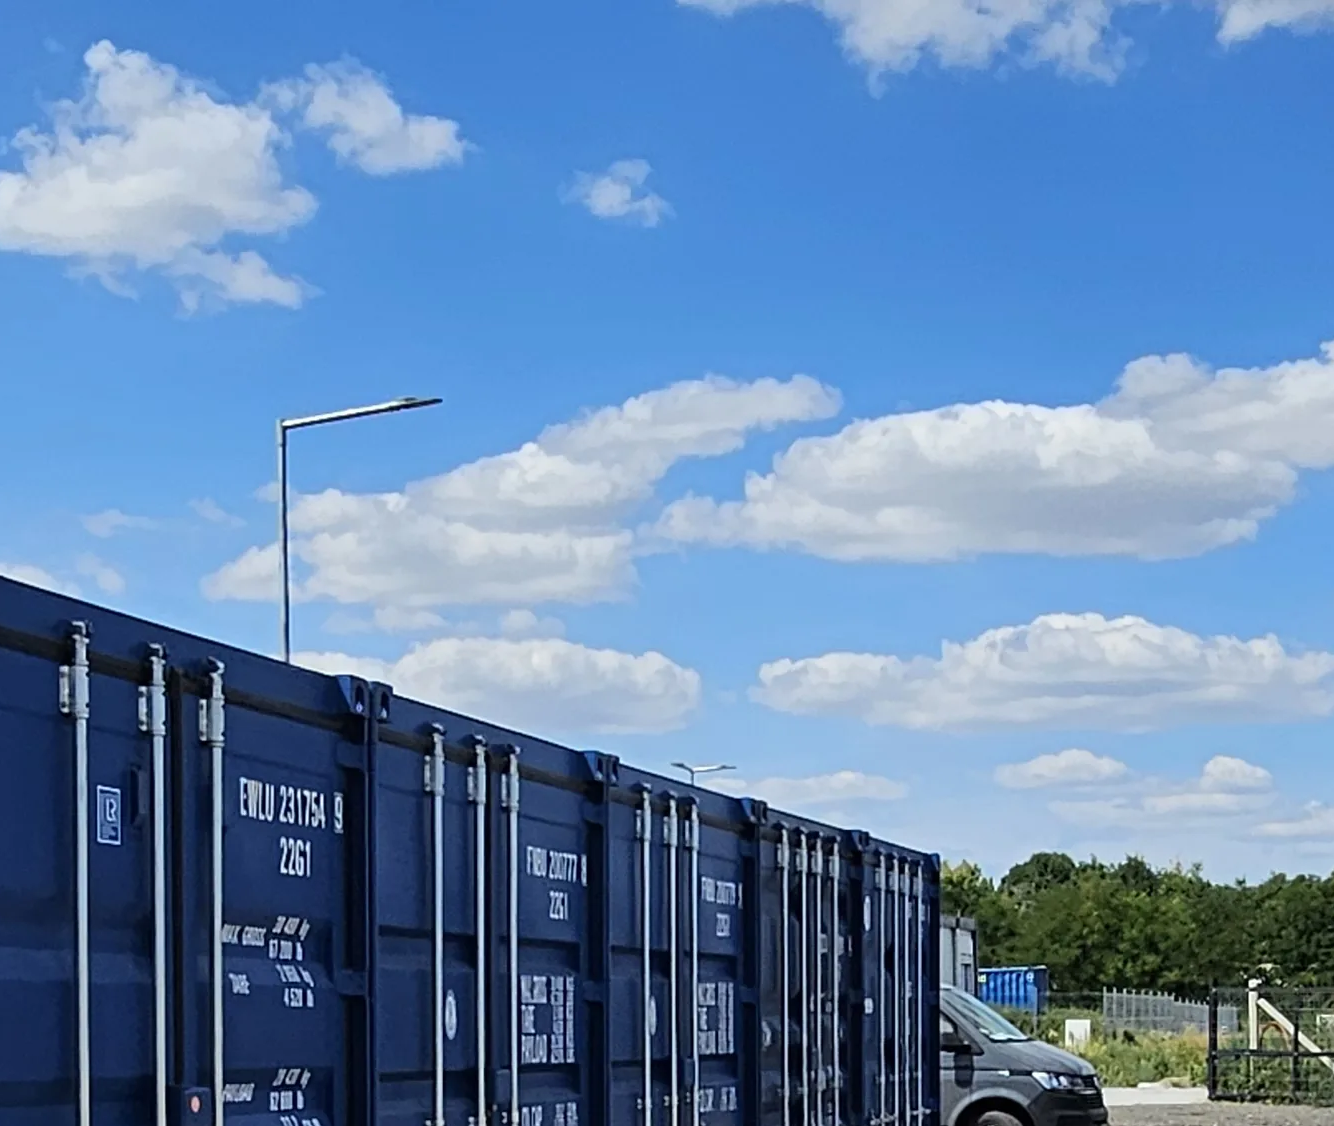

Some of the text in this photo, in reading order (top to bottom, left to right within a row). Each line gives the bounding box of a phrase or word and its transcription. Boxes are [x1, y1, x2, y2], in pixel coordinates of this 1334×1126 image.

[240, 776, 275, 822] EWLU
[279, 784, 327, 829] 231754
[280, 836, 311, 878] 22G1
